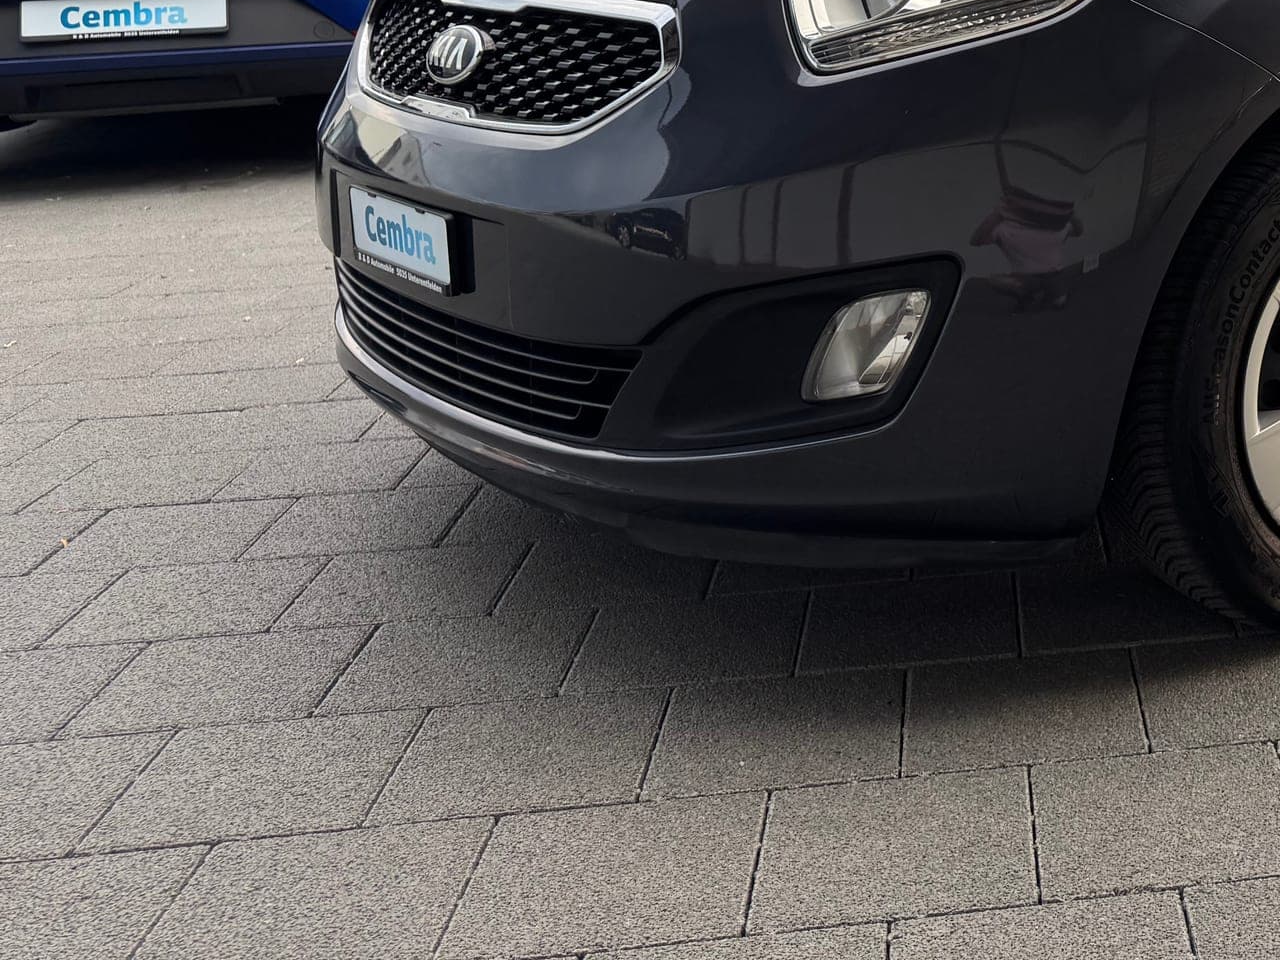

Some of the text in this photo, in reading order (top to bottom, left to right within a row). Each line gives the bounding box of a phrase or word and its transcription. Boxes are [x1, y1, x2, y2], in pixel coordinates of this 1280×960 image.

[60, 0, 188, 29] Cembra
[429, 35, 468, 70] KIA
[365, 205, 436, 265] Cembra
